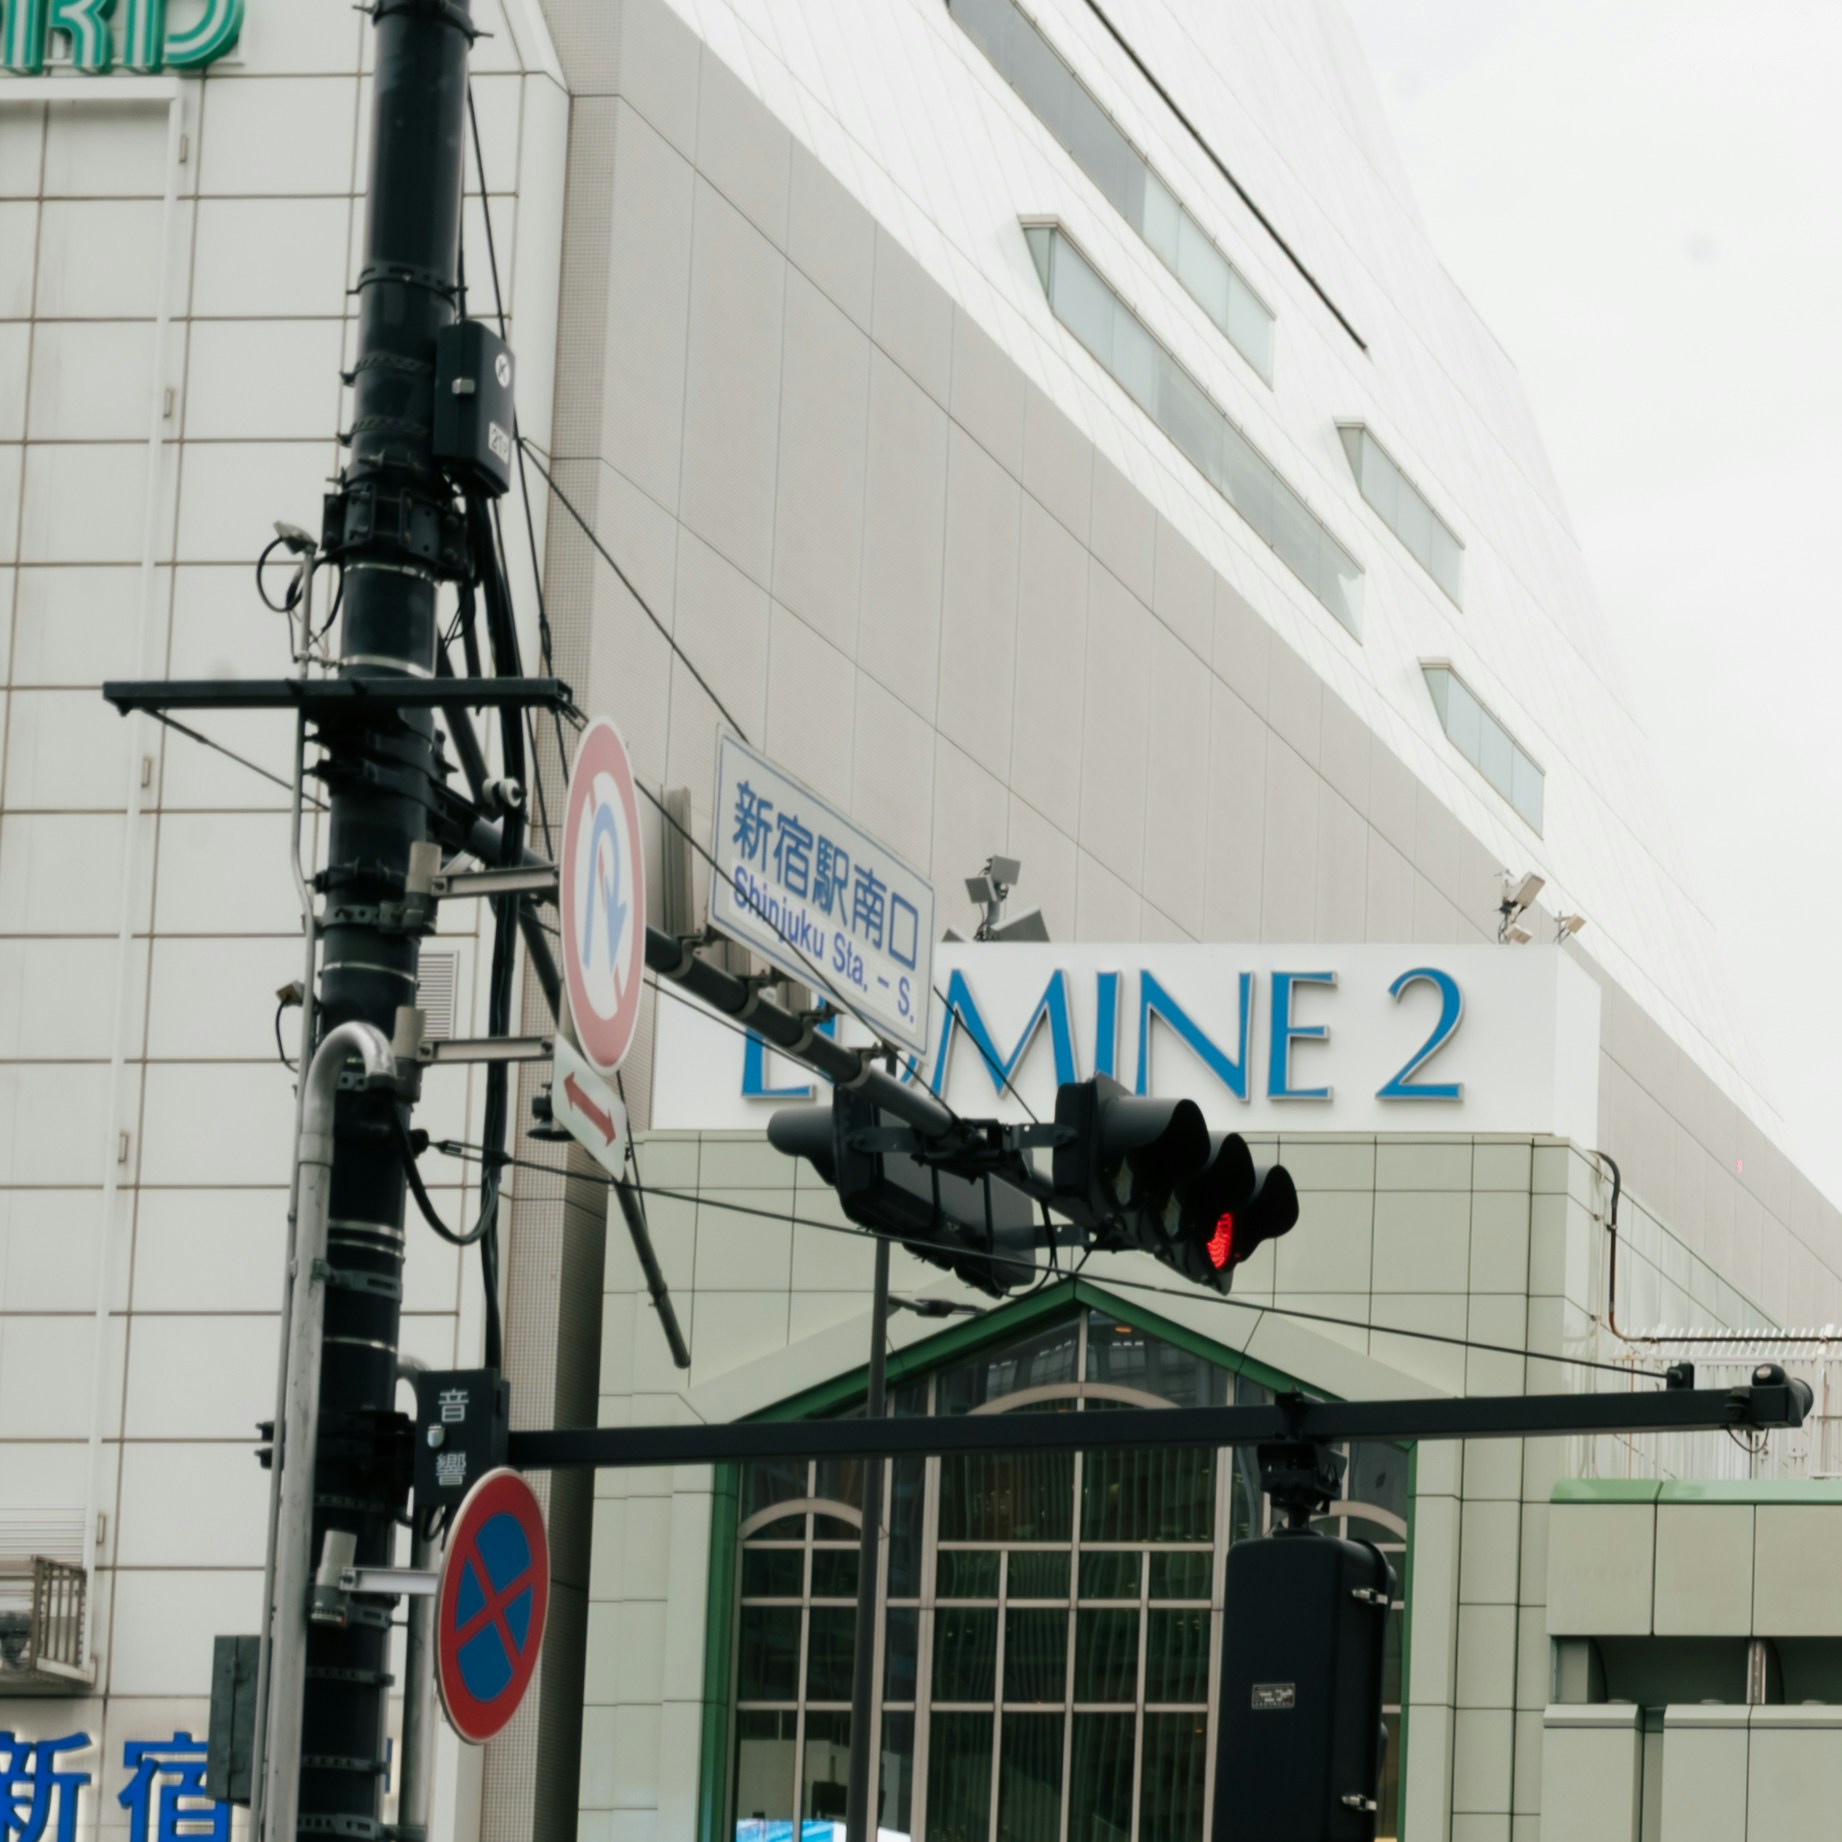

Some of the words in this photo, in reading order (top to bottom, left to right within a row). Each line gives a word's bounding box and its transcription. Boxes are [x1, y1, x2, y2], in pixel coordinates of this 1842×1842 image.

[731, 780, 919, 972] 新宿駅南口
[732, 865, 826, 960] Shinjuku
[832, 926, 869, 992] Sta.
[897, 977, 916, 1024] S.
[740, 968, 1333, 1100] LMINE
[1376, 966, 1465, 1101] 2
[435, 1387, 469, 1487] 音響
